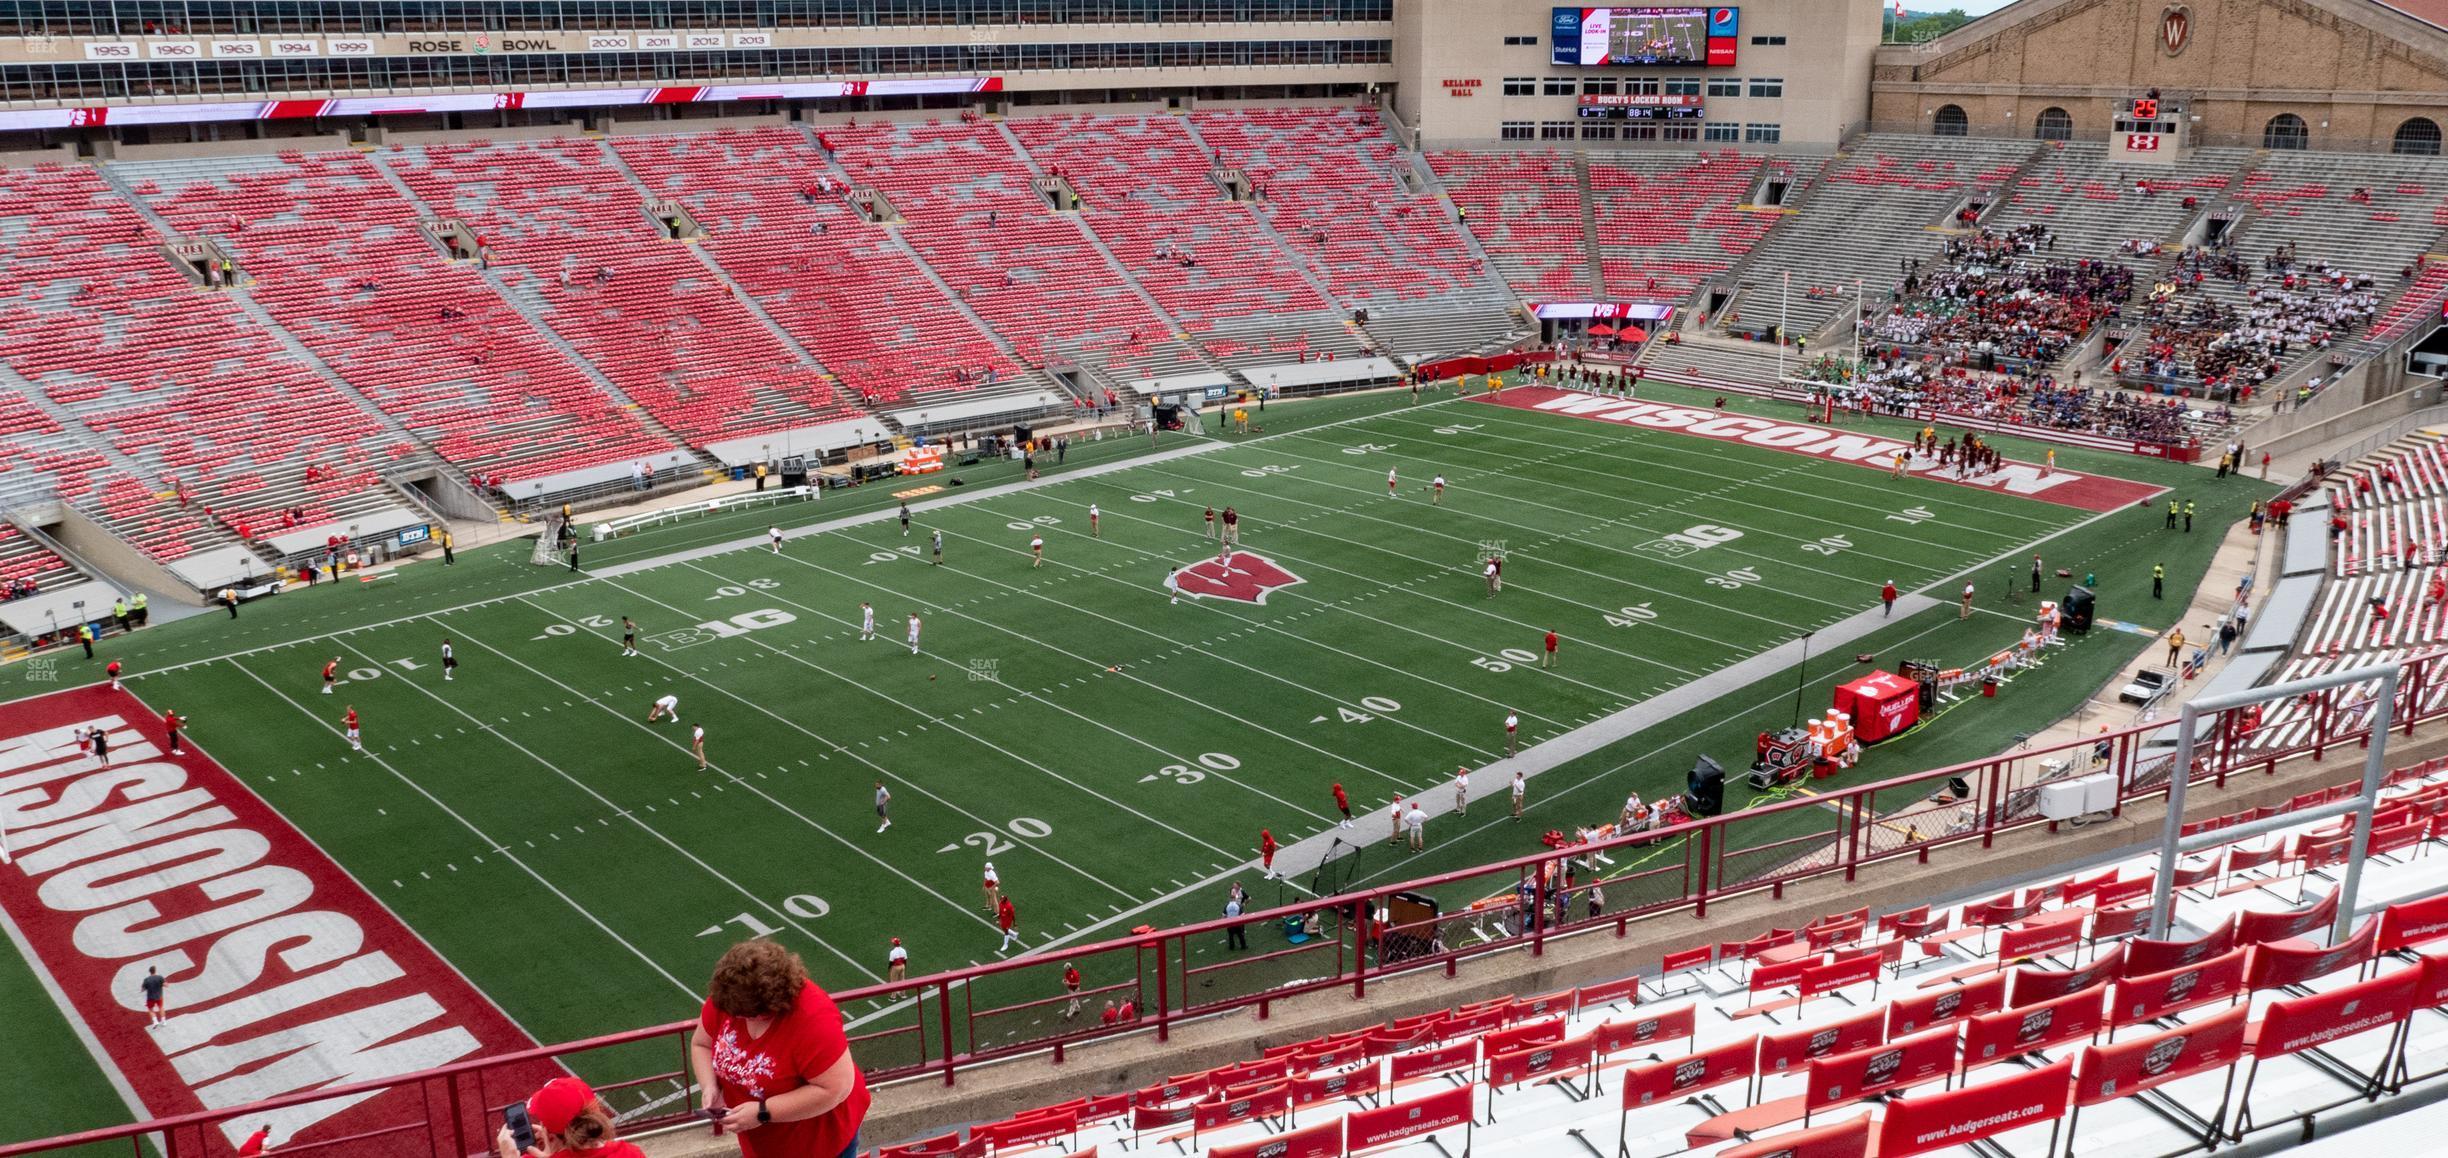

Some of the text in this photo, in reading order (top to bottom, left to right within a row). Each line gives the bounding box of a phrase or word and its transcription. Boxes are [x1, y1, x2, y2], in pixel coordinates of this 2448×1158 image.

[738, 36, 766, 45] 2013
[2166, 20, 2186, 46] W
[219, 44, 254, 54] 1963
[279, 43, 312, 53] 1994
[335, 43, 368, 52] 1999
[409, 40, 556, 52] ROSE BOWL
[592, 38, 628, 48] 2000
[646, 38, 671, 47] 2011
[692, 37, 720, 46] 2012
[94, 46, 130, 56] 1953
[156, 45, 195, 55] 1960
[1442, 79, 1482, 88] KELLNER
[1451, 89, 1473, 97] HALL
[1597, 96, 1683, 105] BUCKY'S LOCKER ROOM
[2135, 101, 2157, 117] 25
[1208, 388, 1223, 396] BTN
[1342, 443, 1386, 455] 20
[1533, 393, 2083, 494] WISCONSIN
[1241, 464, 1290, 477] 30
[1130, 488, 1176, 502] 40
[1007, 515, 1062, 530] 50
[1886, 509, 1935, 525] 10
[401, 528, 424, 542] BTN
[870, 545, 921, 564] 40
[1801, 537, 1853, 556] 20
[1163, 550, 1308, 606] W
[1705, 570, 1762, 590] 30
[717, 577, 781, 599] 30
[1602, 604, 1658, 629] 40
[545, 614, 614, 636] 20
[1472, 647, 1540, 673] 50
[1335, 696, 1401, 724] 40
[1158, 751, 1241, 785] 30
[963, 816, 1053, 857] 20
[725, 893, 830, 940] 10
[1814, 971, 1871, 989] www.badgerseats.com
[2283, 1011, 2394, 1050] www.badgerseats.com
[1403, 1058, 1467, 1078] www.badgerseats.com
[1366, 1114, 1460, 1144] www.badgerseats.com
[1916, 1104, 2044, 1145] www.badgerseats.com
[1007, 1128, 1067, 1144] www.badgerseats.com
